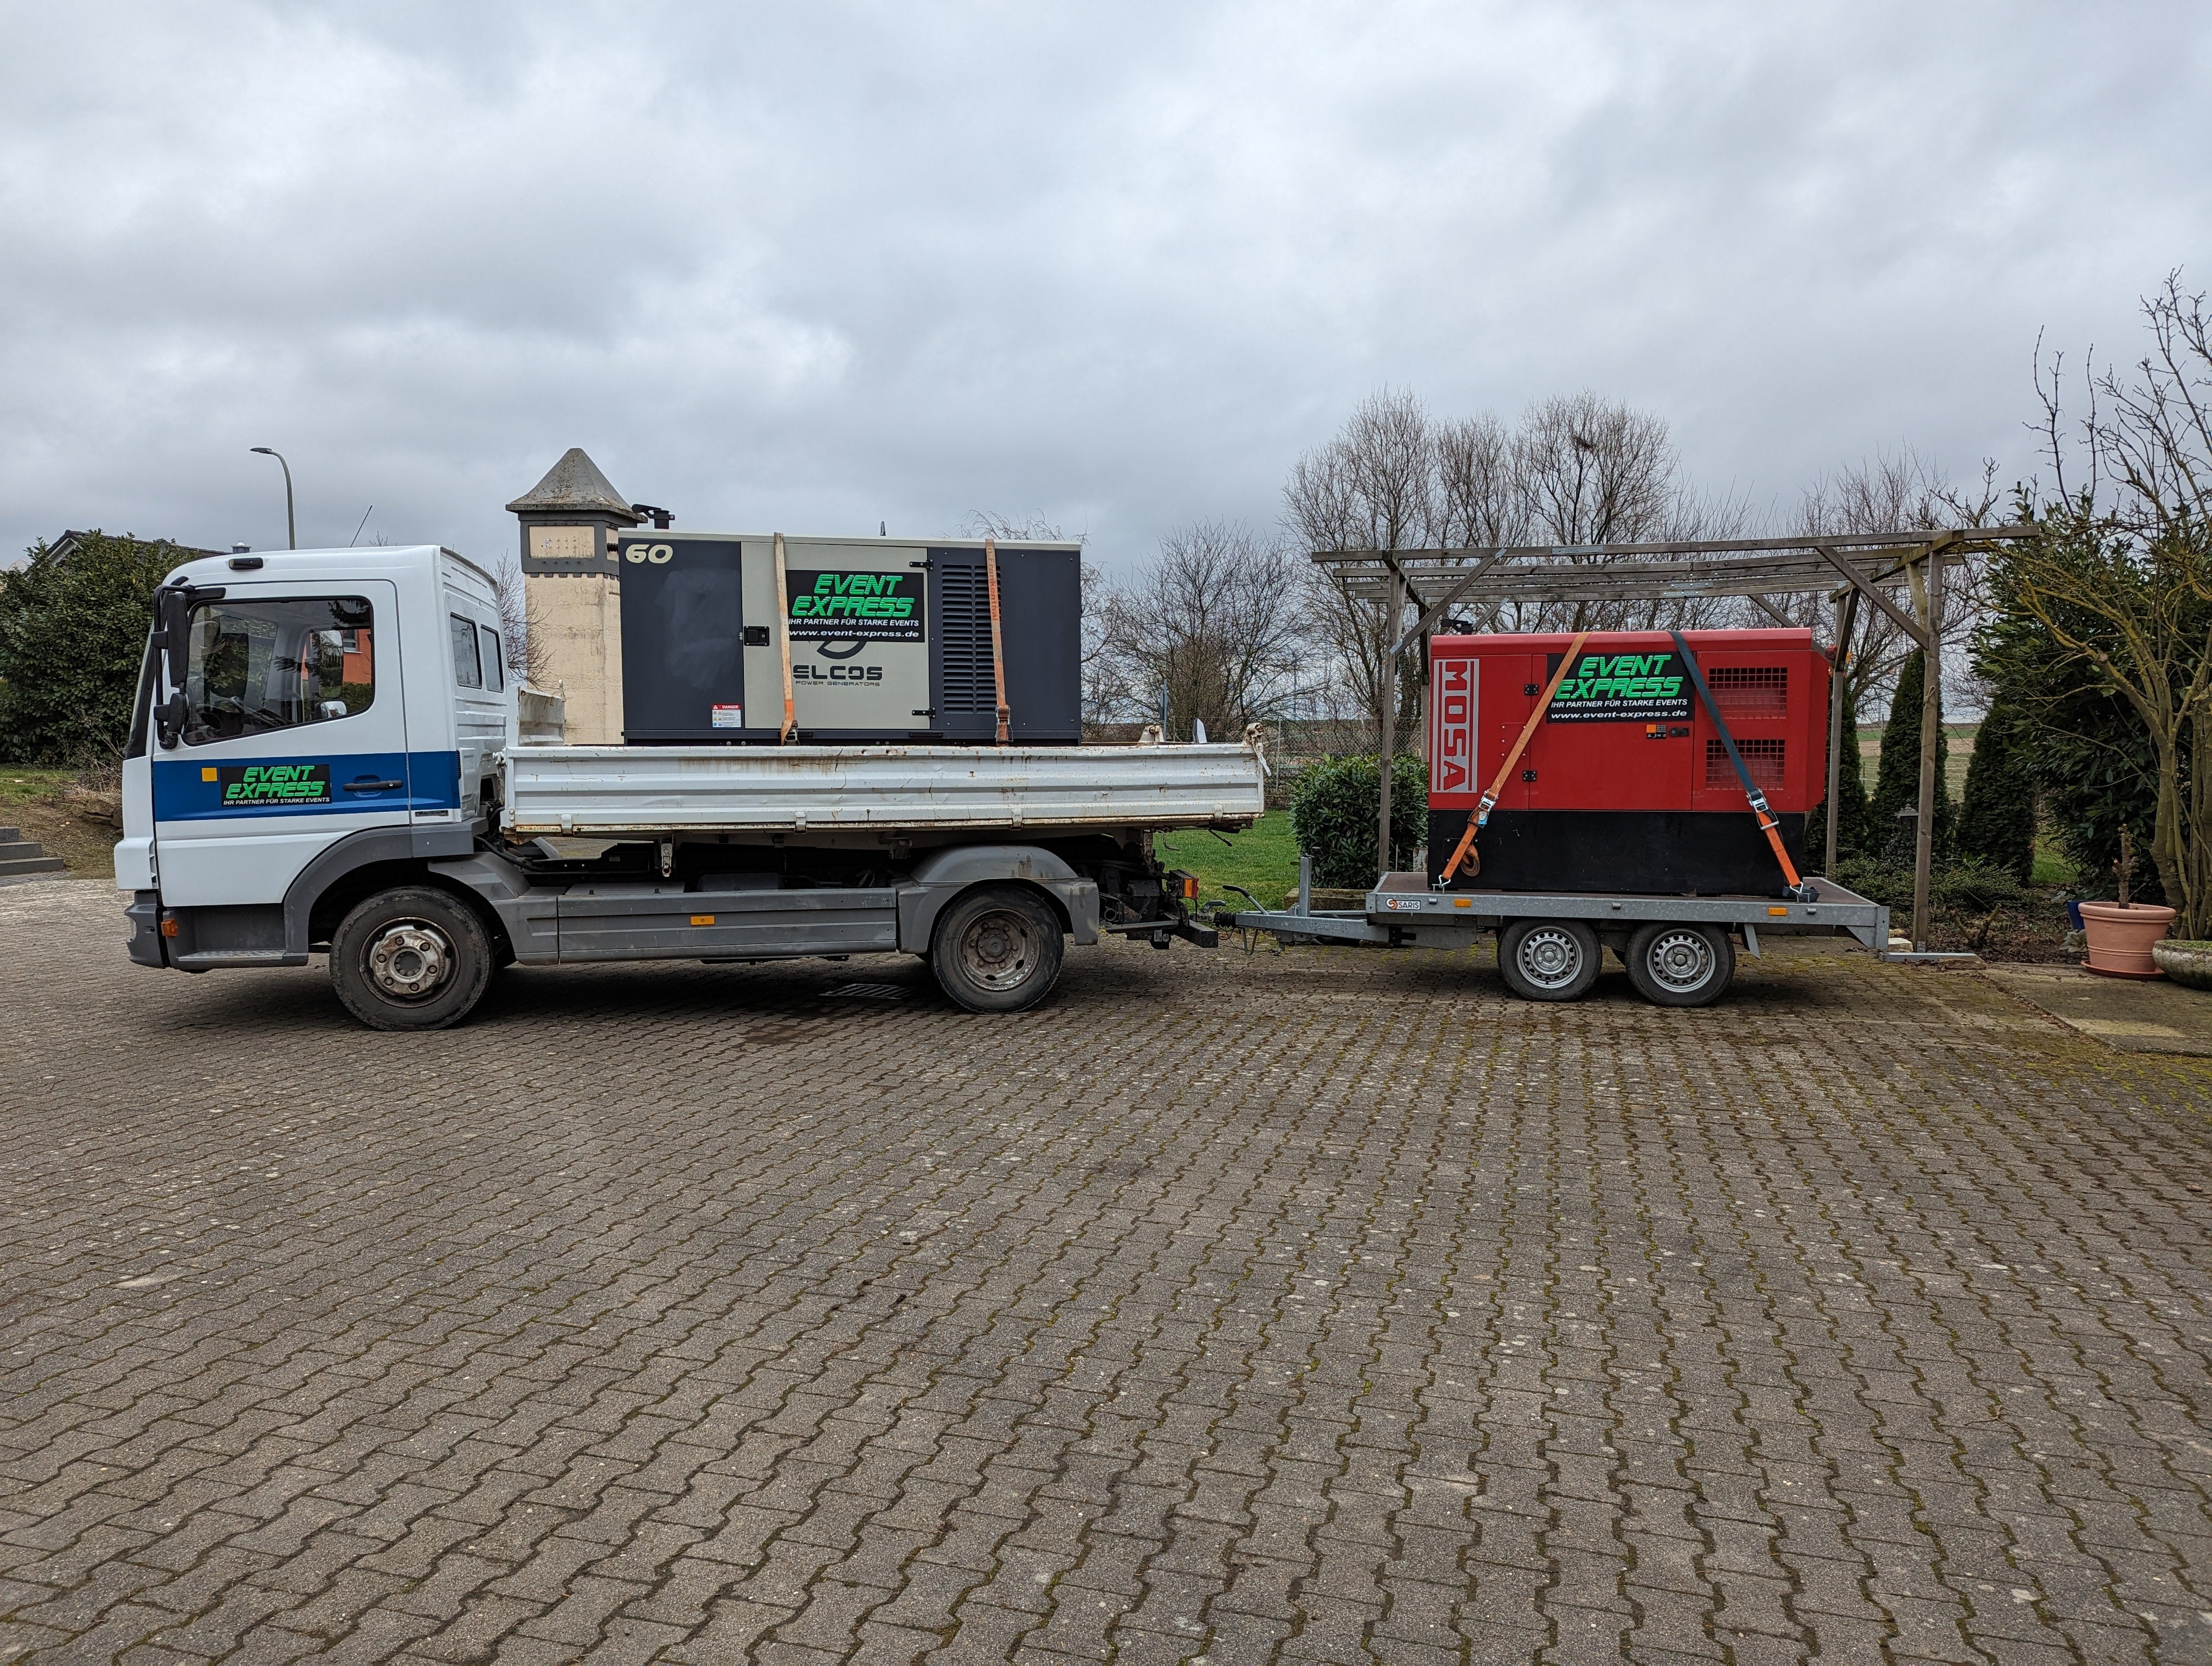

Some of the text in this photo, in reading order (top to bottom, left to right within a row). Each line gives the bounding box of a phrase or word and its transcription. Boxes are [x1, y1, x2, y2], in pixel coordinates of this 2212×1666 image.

[626, 544, 673, 563] 60
[814, 574, 903, 595] EVENT
[988, 558, 998, 620] Frankenthal
[792, 595, 915, 617] EXPRESS
[841, 617, 857, 626] FÜR
[789, 630, 919, 638] www.event-express.de
[793, 664, 883, 681] ELCOS
[1578, 655, 1672, 677] EVENT
[1555, 676, 1684, 699] EXPRESS
[1551, 710, 1687, 719] www.event-express.de
[1443, 661, 1468, 791] MOSA
[243, 765, 315, 782] EVENT
[226, 781, 325, 799] EXPRESS
